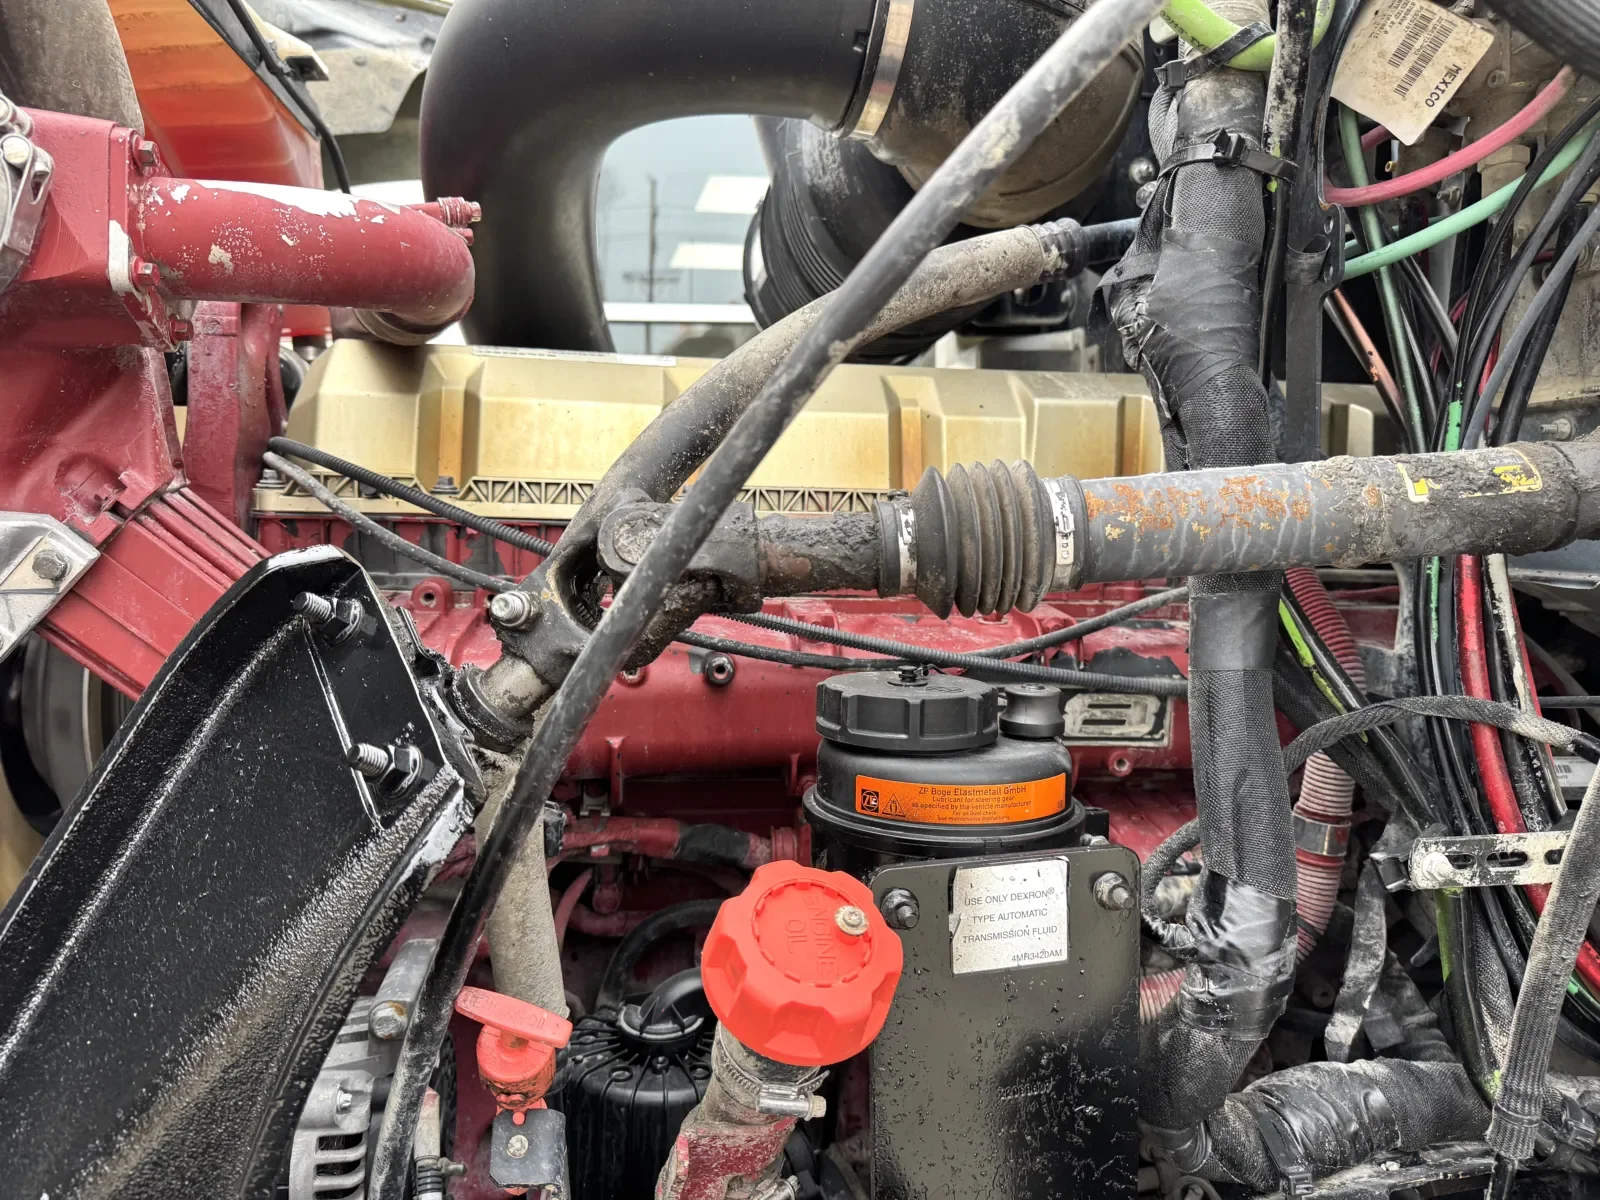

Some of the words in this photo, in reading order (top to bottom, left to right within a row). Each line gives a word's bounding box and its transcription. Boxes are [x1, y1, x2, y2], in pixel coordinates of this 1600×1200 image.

[1424, 63, 1462, 108] MEXICO
[931, 788, 951, 796] Boge
[954, 787, 1001, 796] Elastmetall
[1004, 786, 1026, 794] GmbH
[964, 897, 982, 906] USE
[985, 895, 1008, 904] ONLY
[972, 914, 995, 924] TYPE
[998, 908, 1048, 920] AUTOMATIC
[786, 919, 808, 953] OIL
[804, 893, 840, 977] ENGINE
[963, 929, 1030, 943] TRANSMISSION
[1032, 926, 1058, 935] FLUID
[1012, 950, 1062, 962] 4MR3420AM
